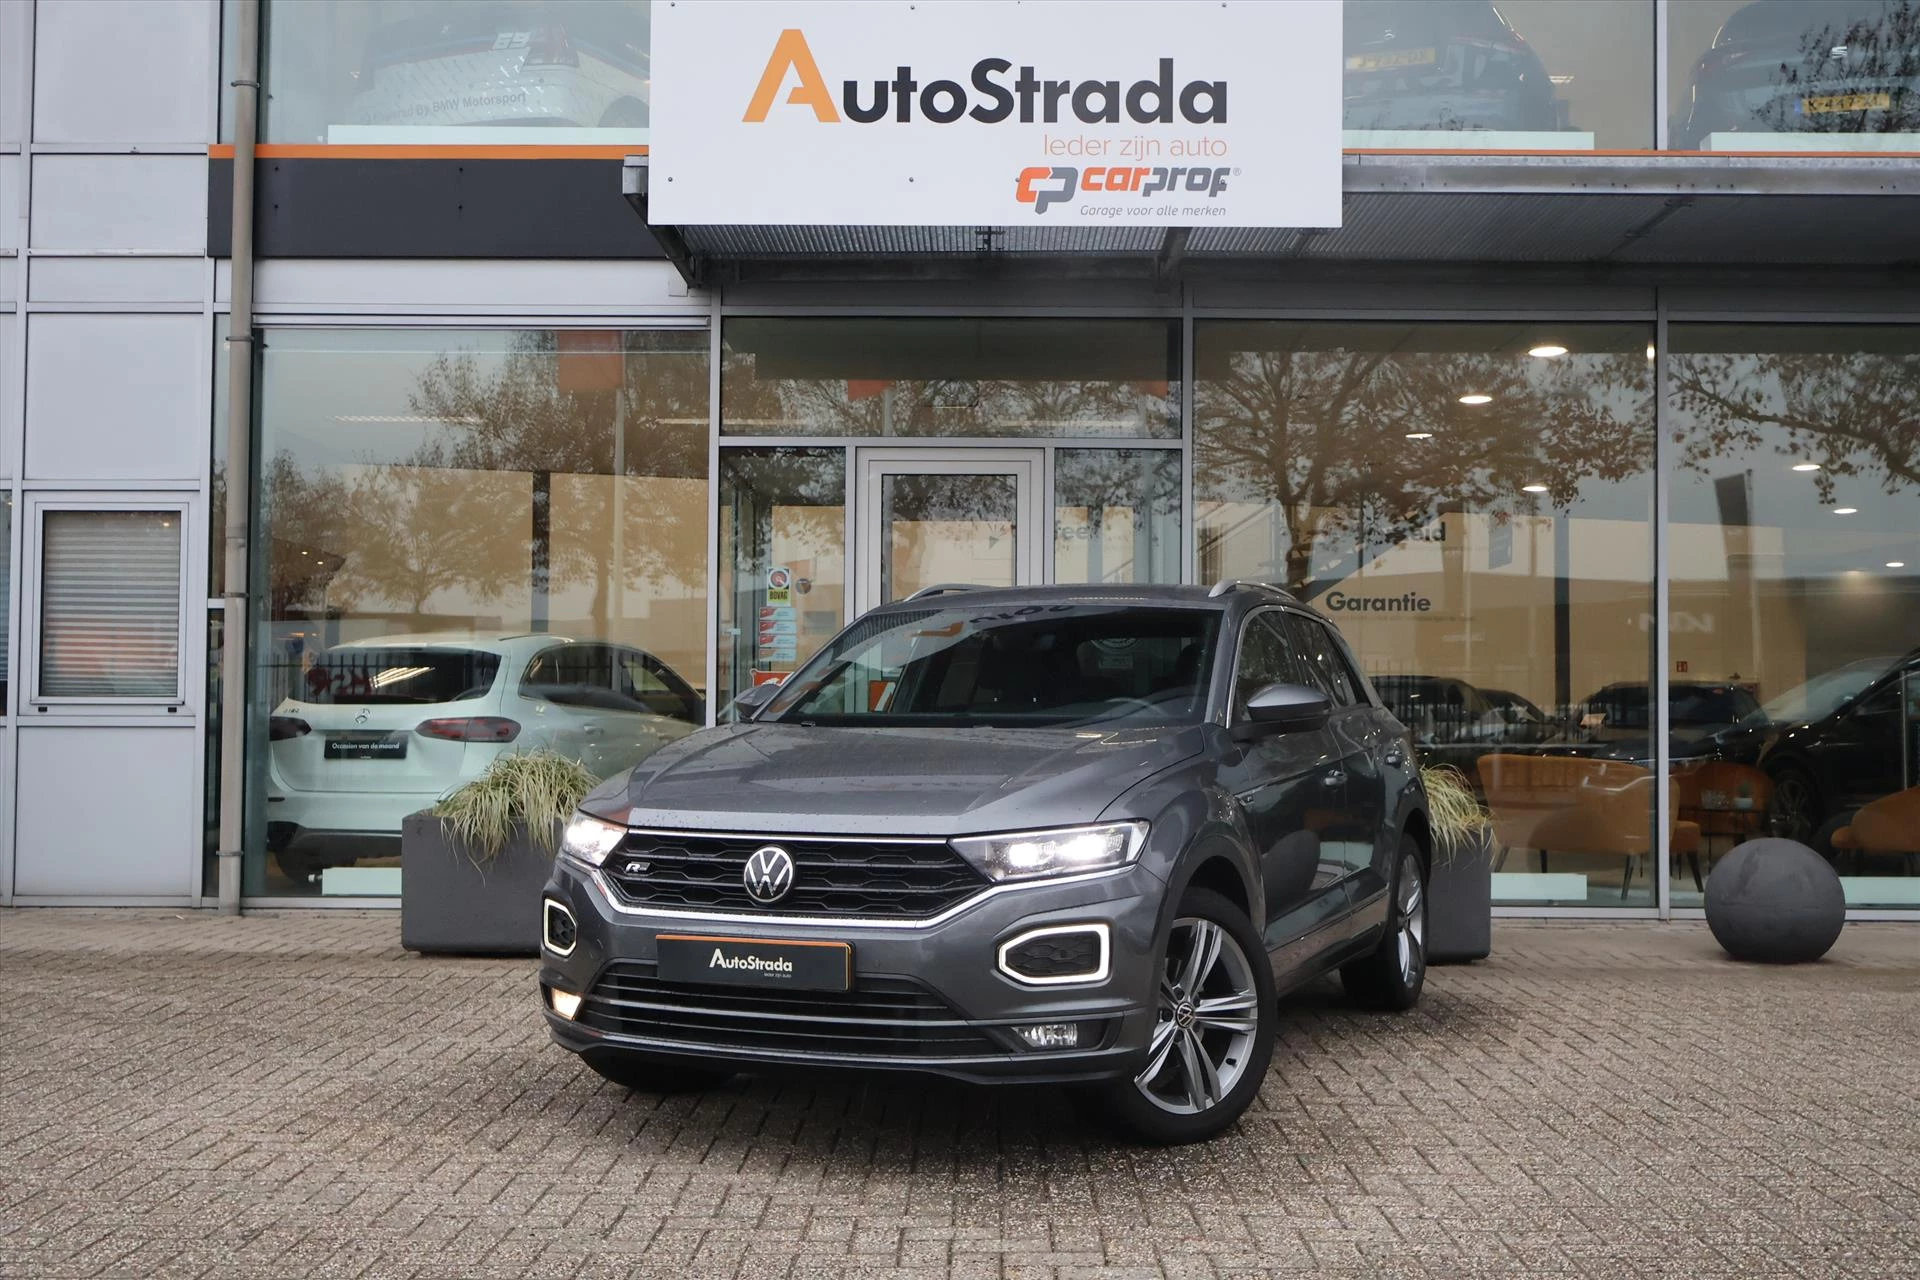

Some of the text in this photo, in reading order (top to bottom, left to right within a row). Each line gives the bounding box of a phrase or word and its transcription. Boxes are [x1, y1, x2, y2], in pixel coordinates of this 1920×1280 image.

[742, 29, 1227, 124] AutoStrada
[433, 97, 459, 113] BMW
[463, 92, 527, 109] Motorsport
[1044, 134, 1227, 161] Ieder zijn auto
[1080, 167, 1230, 197] carprof
[1080, 205, 1226, 218] Garage voor alle merken
[769, 590, 788, 600] BOVAG
[1325, 591, 1431, 612] Garantie
[709, 948, 792, 972] AutoStrada
